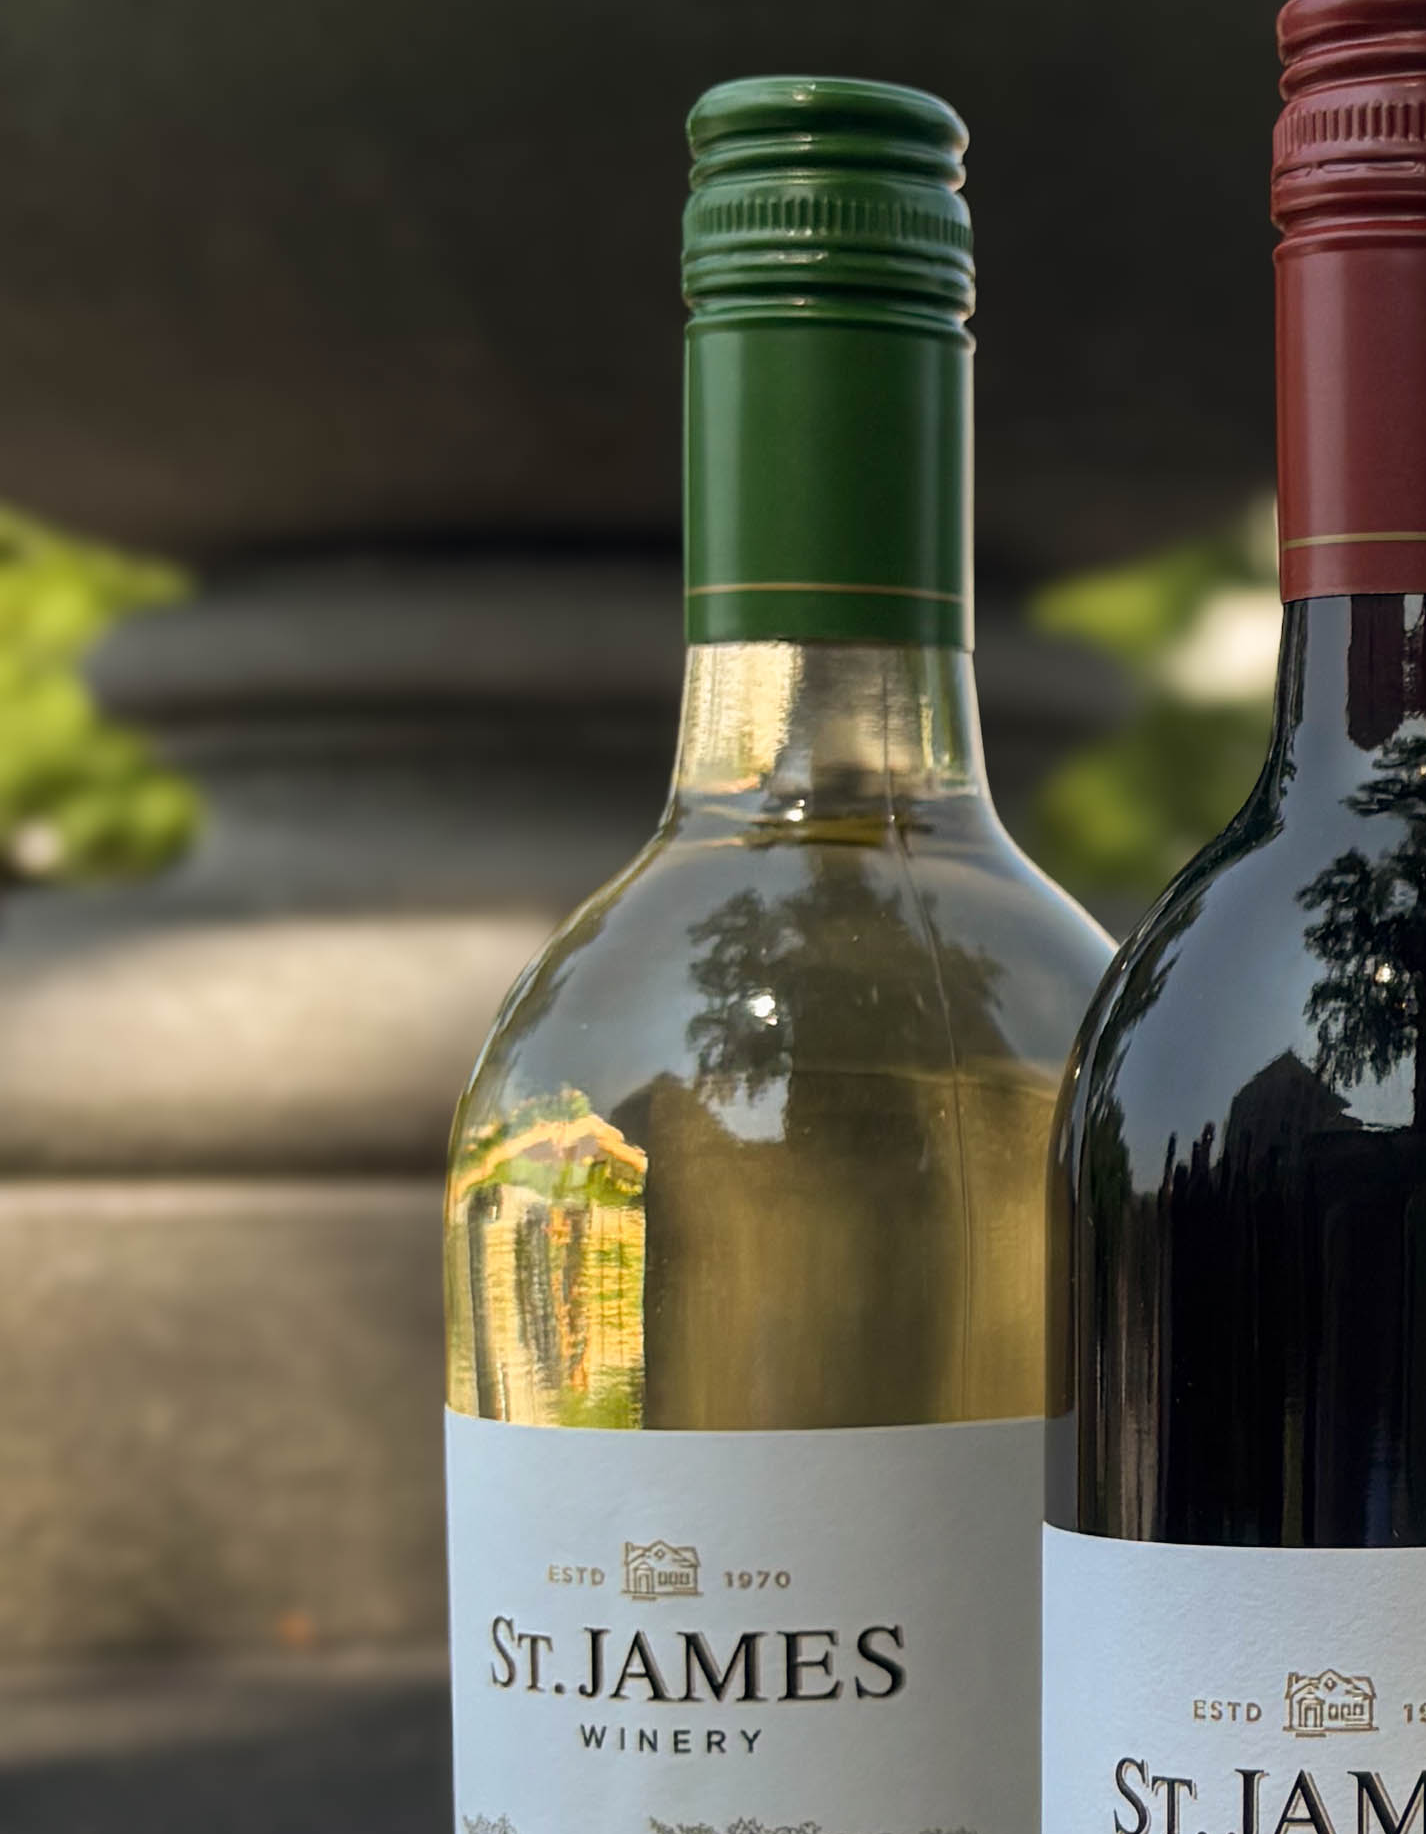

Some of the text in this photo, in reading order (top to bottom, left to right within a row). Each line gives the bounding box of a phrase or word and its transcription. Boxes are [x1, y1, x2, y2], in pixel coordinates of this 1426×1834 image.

[548, 1566, 791, 1589] ESTD 1970
[578, 1625, 907, 1703] JAMES
[1193, 1700, 1261, 1722] ESTD
[580, 1723, 763, 1754] WINERY
